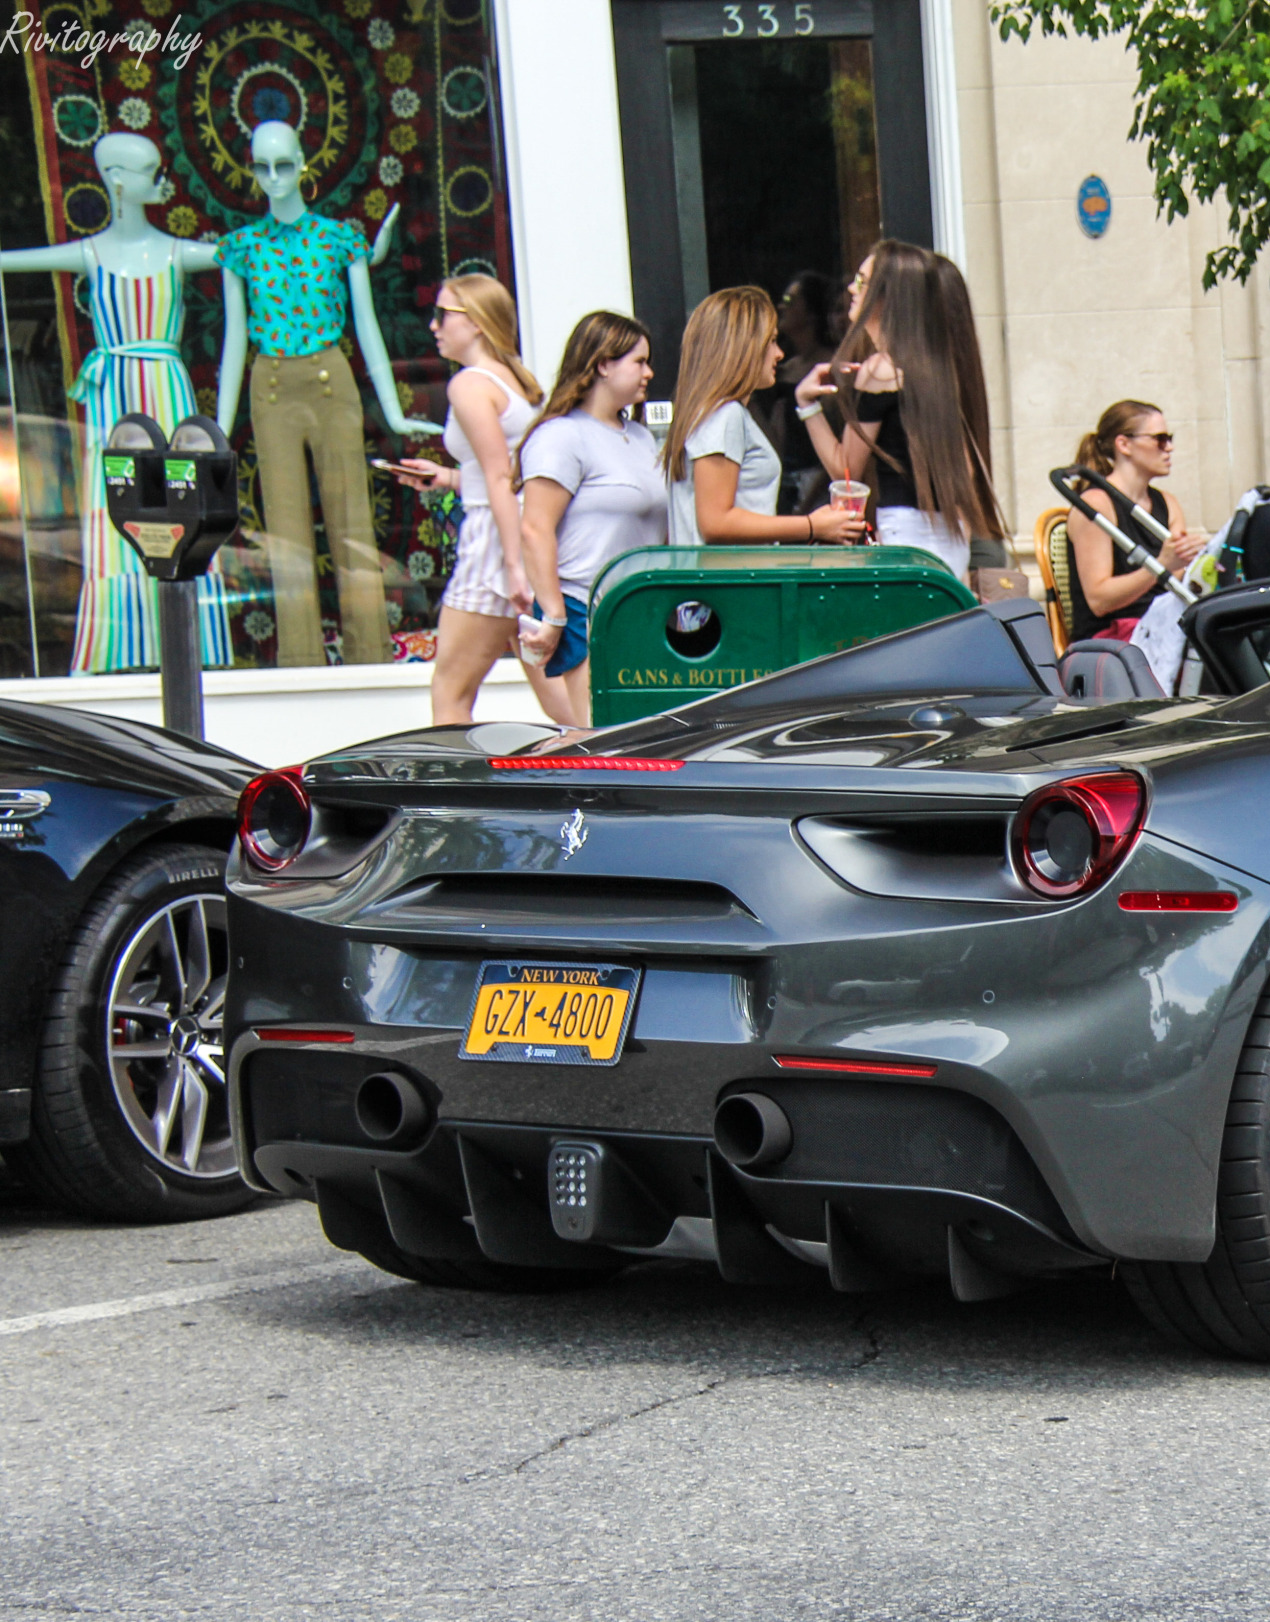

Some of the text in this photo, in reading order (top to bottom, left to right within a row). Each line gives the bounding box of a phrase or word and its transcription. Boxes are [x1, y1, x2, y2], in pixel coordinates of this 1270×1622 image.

[723, 3, 815, 38] 335
[618, 668, 668, 685] CANS
[672, 672, 682, 685] &
[520, 968, 601, 986] NEW YORK
[484, 989, 614, 1040] GZX 4800
